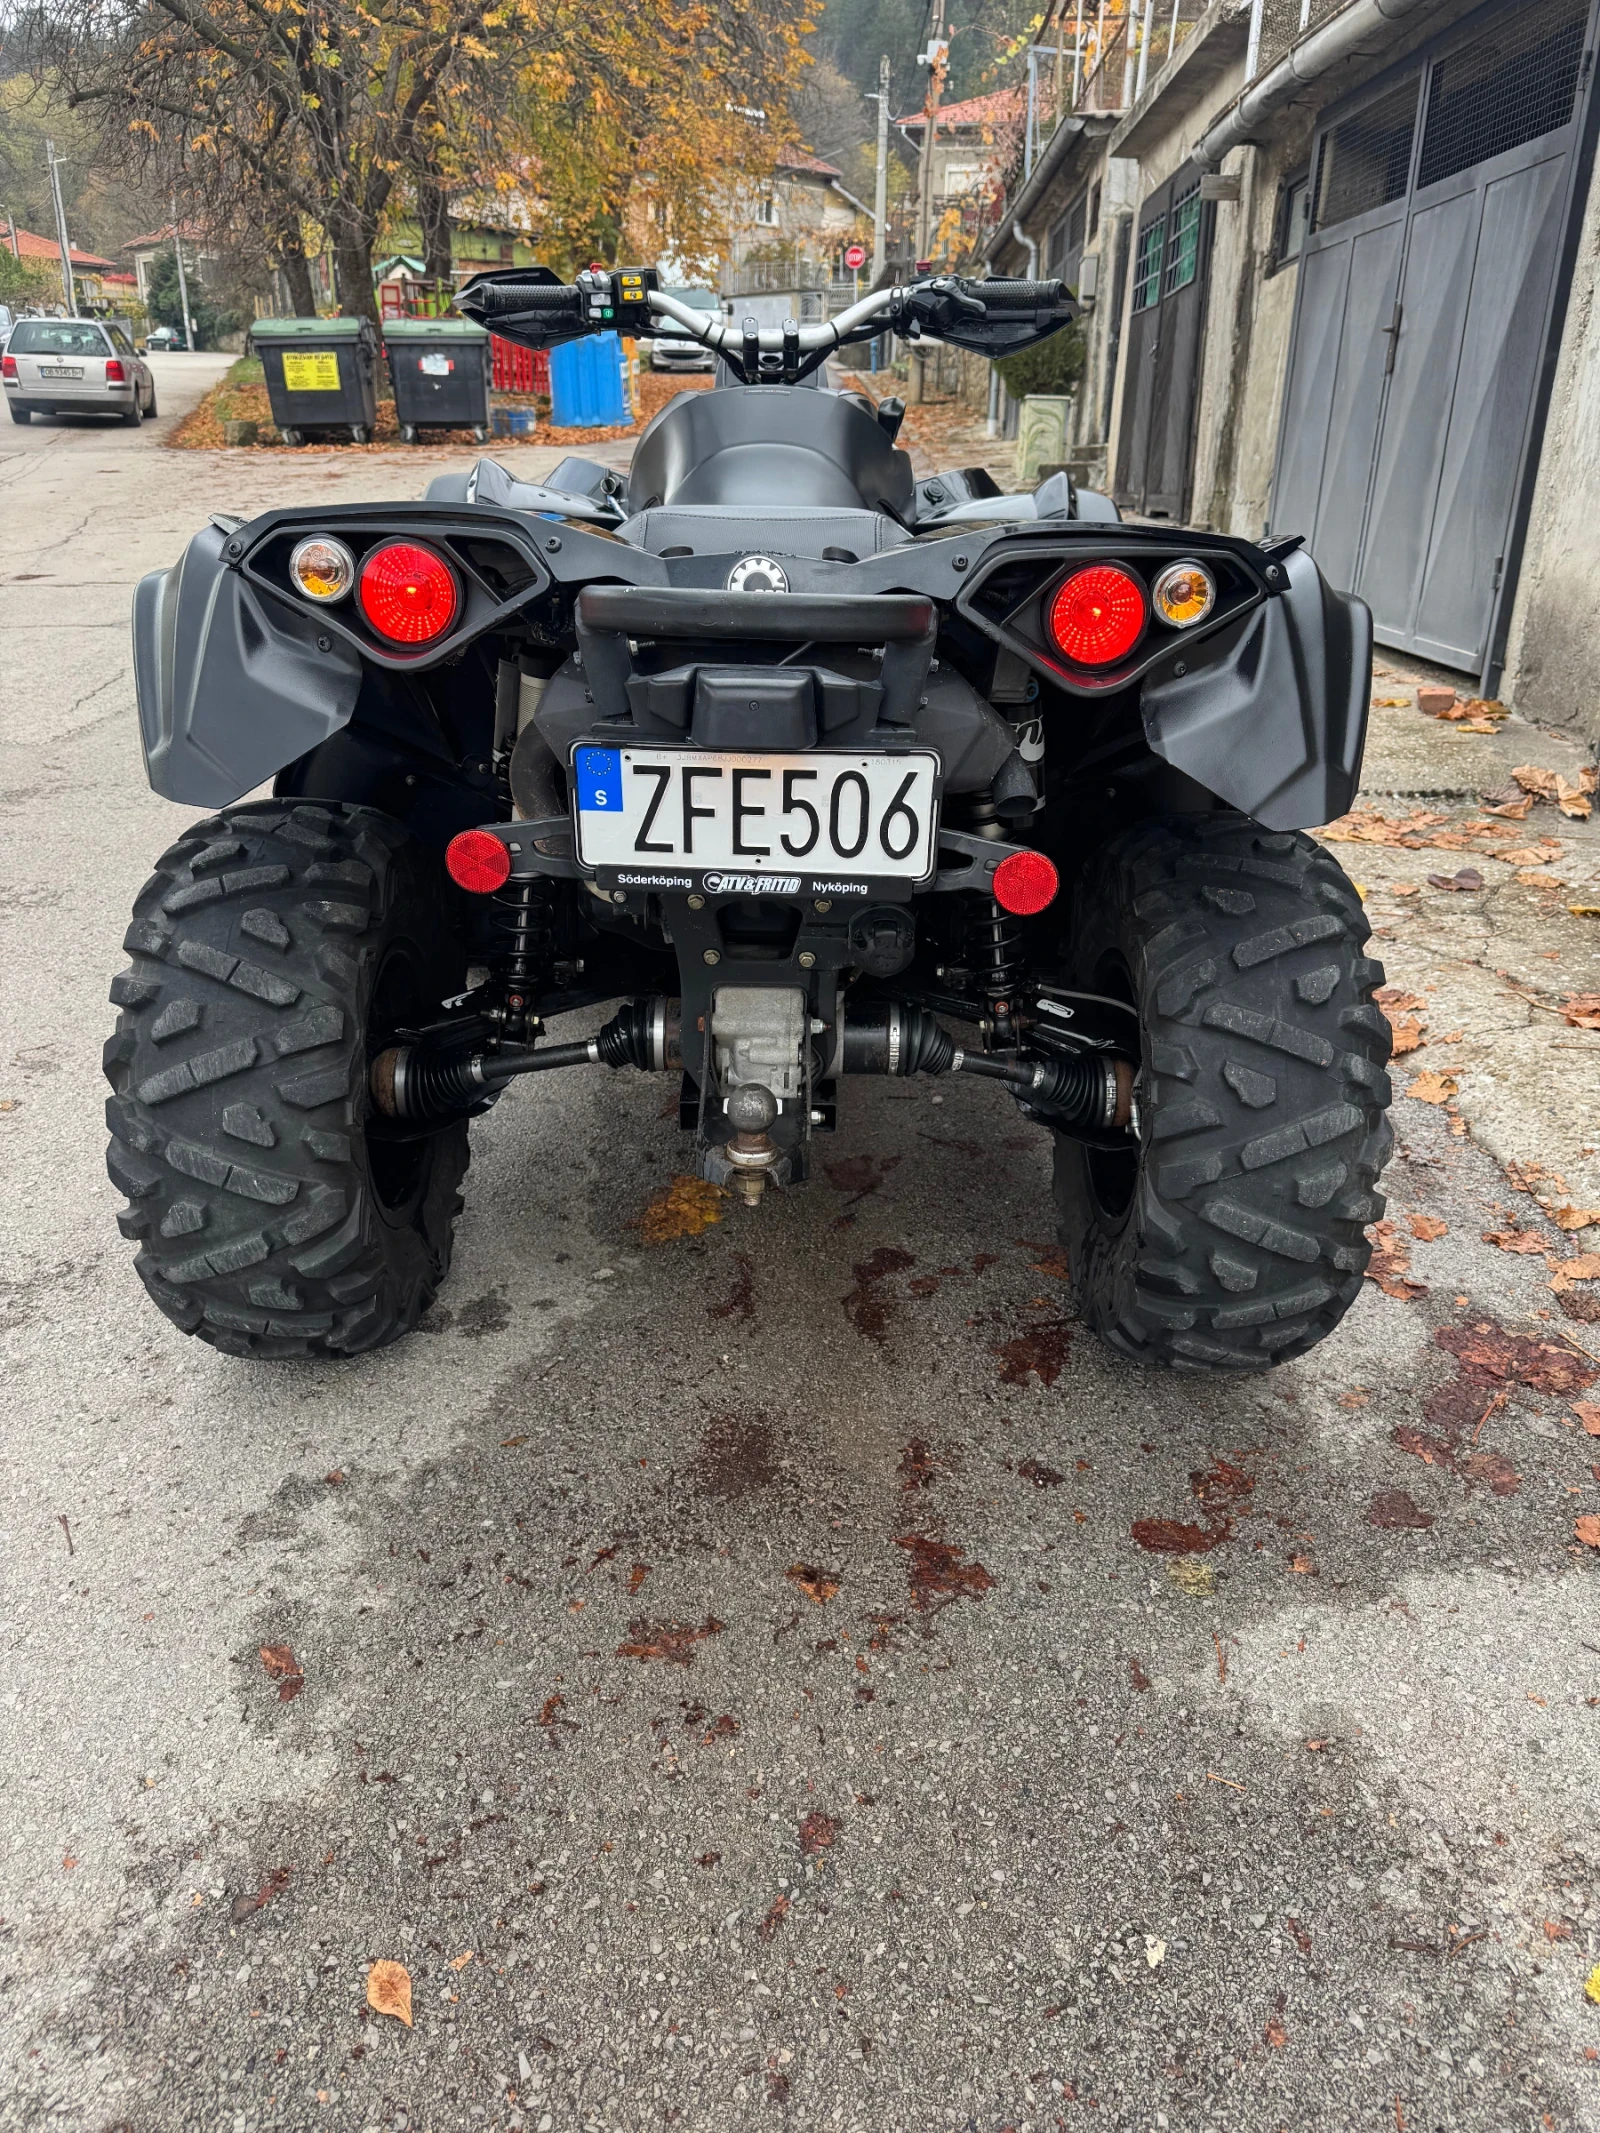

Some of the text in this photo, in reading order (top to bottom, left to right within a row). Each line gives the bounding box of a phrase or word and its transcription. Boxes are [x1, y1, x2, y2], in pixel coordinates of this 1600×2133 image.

[596, 789, 608, 807] S
[633, 764, 919, 860] ZFE506
[617, 873, 693, 889] Söderköping
[812, 881, 869, 894] Nyköping
